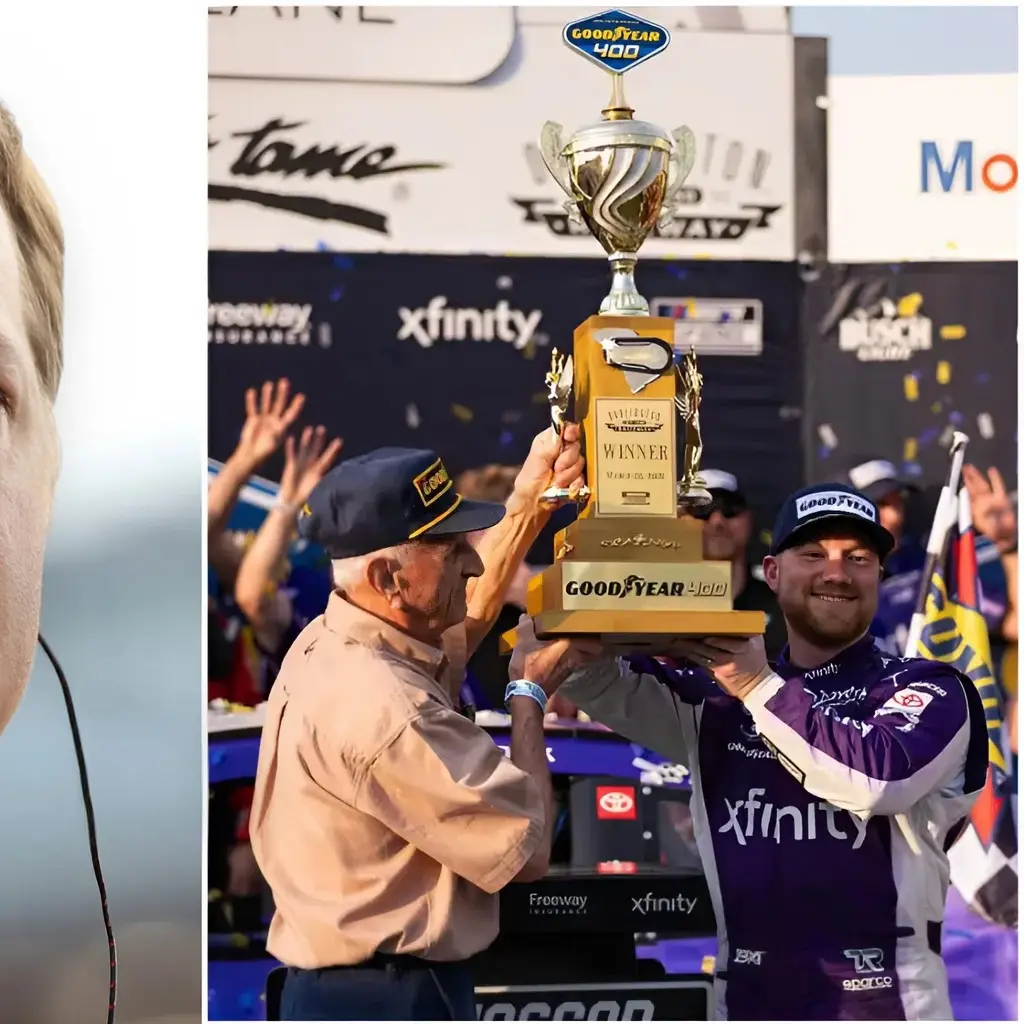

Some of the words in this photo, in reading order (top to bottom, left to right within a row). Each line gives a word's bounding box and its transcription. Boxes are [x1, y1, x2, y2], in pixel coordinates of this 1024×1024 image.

[571, 26, 660, 41] GOODYEAR
[593, 43, 640, 58] 400
[208, 302, 312, 335] reeway
[397, 296, 543, 348] xfinity
[604, 444, 668, 460] WINNER
[800, 495, 874, 518] GOODYEAR
[566, 575, 684, 598] GOODYEAR
[719, 788, 868, 849] xfinity
[631, 892, 697, 915] xfinity
